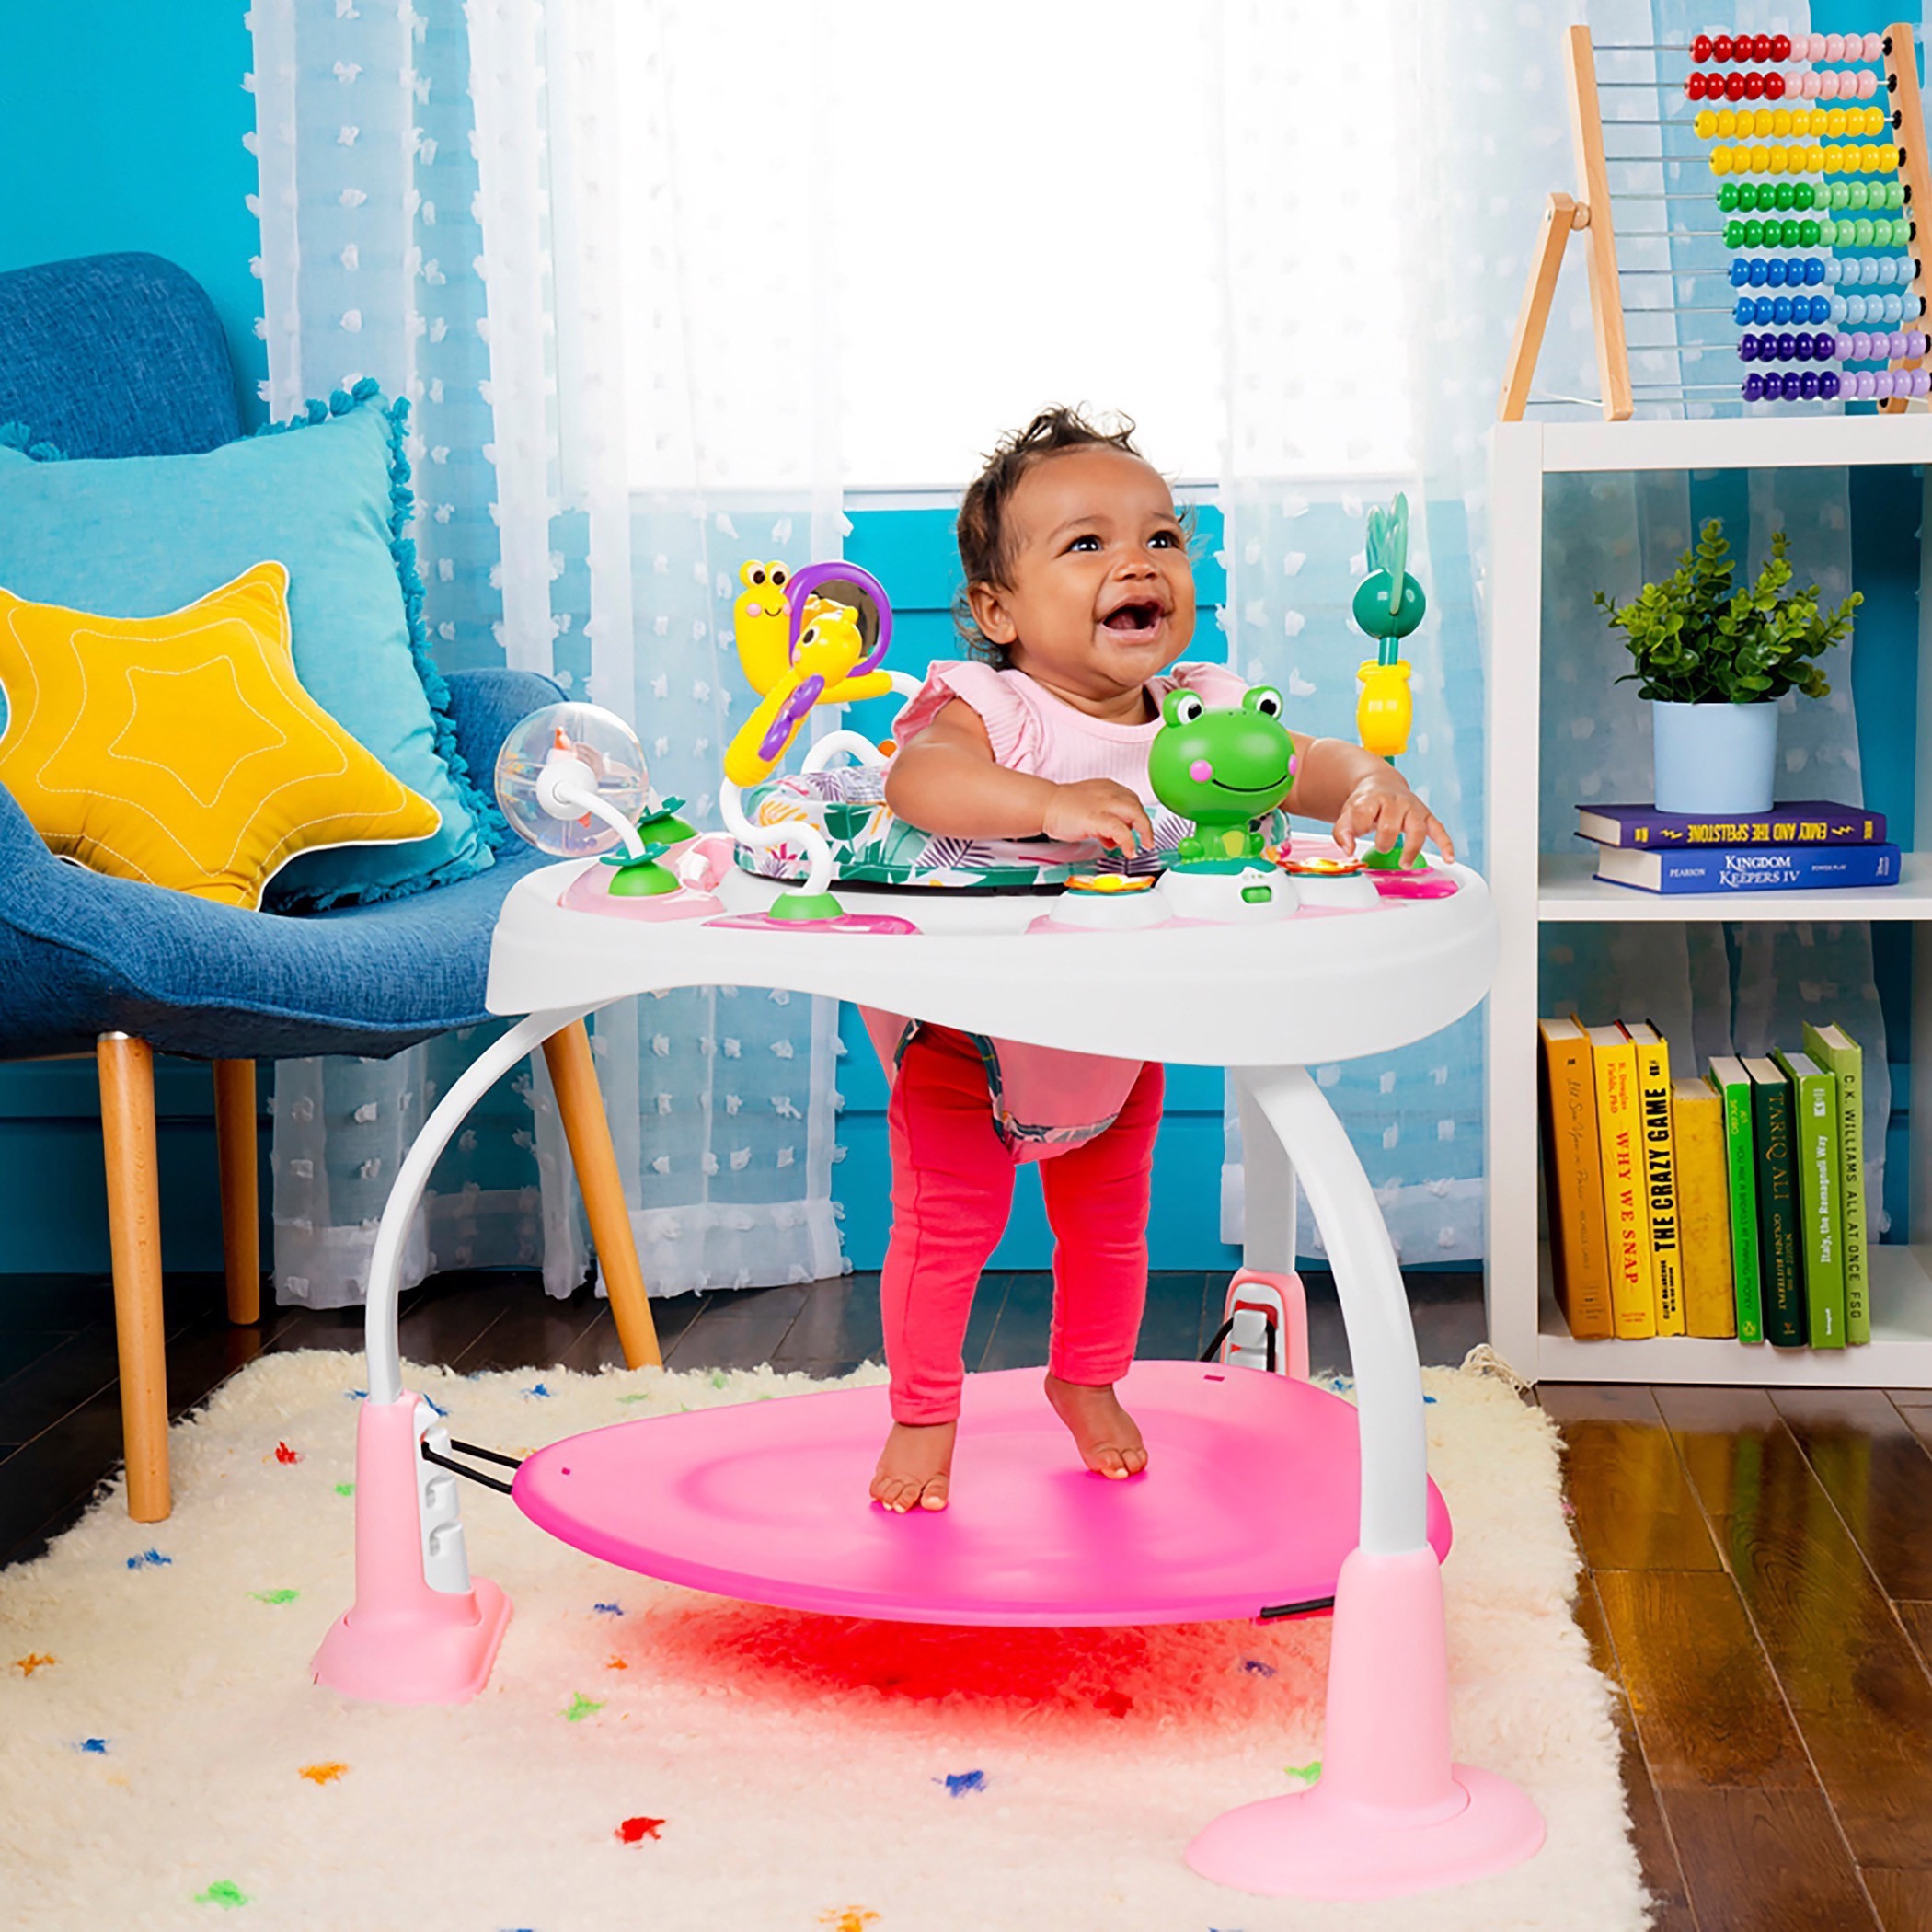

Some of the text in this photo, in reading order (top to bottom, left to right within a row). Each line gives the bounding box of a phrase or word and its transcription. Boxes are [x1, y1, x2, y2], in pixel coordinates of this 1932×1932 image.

[1687, 822, 1826, 842] EMILY AND THE SPELLSTONE
[1670, 868, 1706, 878] PEARSON
[1725, 855, 1791, 868] KINGDOM
[1719, 871, 1800, 888] KEEPERS IV
[1844, 1075, 1857, 1182] C. K. WILLIAMS
[1765, 1091, 1789, 1200] TARIQ ALI
[1816, 1135, 1828, 1157] Way
[1645, 1088, 1675, 1252] THE CRAZY GAME
[1616, 1132, 1639, 1284] WHY WE SNAP
[1820, 1217, 1829, 1234] the
[1847, 1190, 1860, 1281] ALL AT ONCE
[1820, 1236, 1833, 1263] Italy,
[1850, 1292, 1862, 1319] FSG
